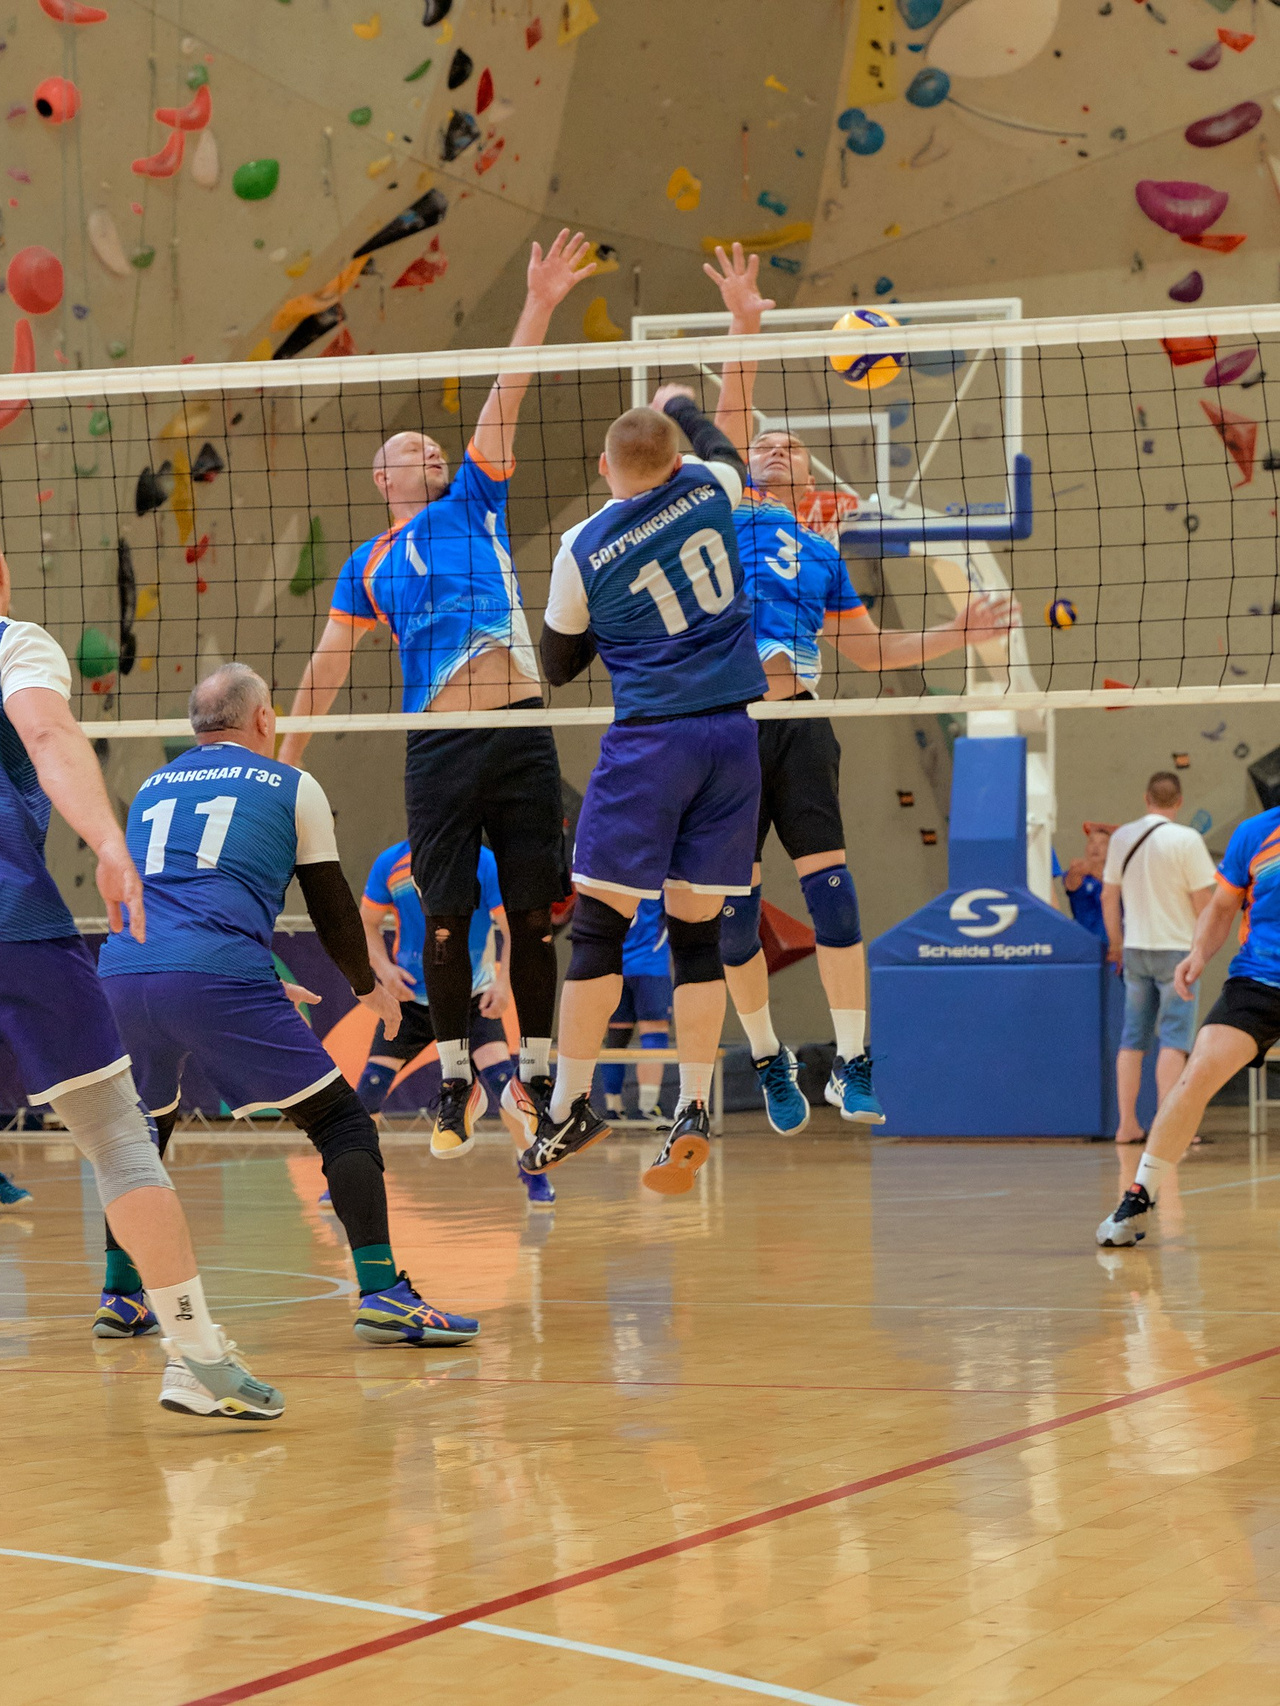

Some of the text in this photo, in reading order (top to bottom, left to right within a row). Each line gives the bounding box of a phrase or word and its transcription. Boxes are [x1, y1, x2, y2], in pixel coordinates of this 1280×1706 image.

[588, 484, 717, 571] БОГУЧАНСКАЯ ГЭС
[764, 527, 804, 580] 3
[628, 527, 735, 637] 10
[138, 766, 283, 792] ОГУЧАНСКАЯ ГЭС
[141, 795, 238, 876] 11
[992, 943, 1053, 960] Sports
